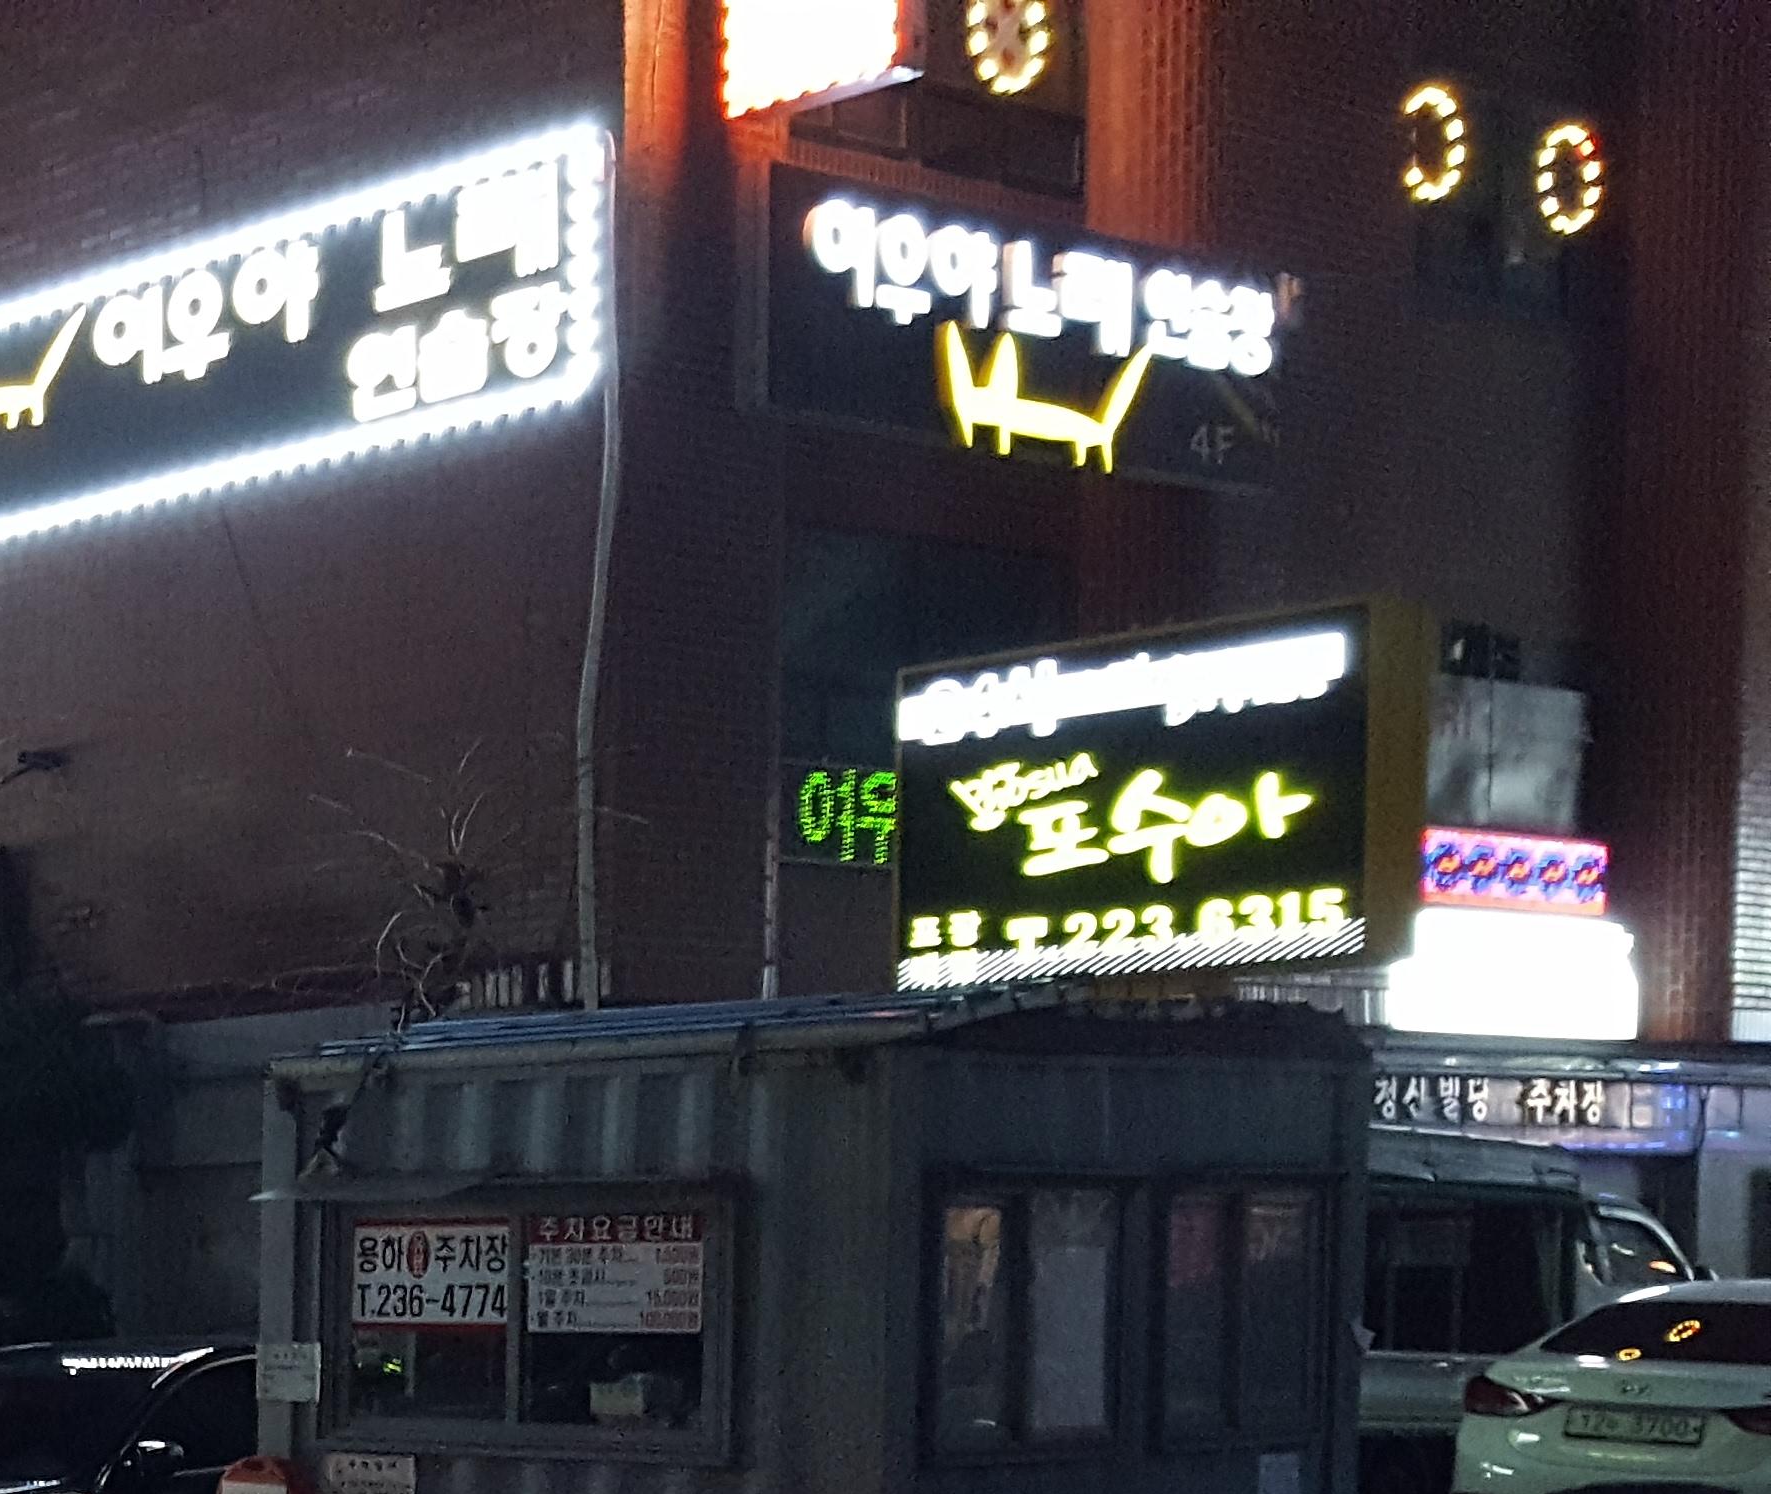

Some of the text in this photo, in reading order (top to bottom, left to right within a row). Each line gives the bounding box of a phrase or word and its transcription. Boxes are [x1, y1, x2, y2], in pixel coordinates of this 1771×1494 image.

[807, 200, 997, 328] 여우야
[93, 239, 319, 384] 여우야
[1018, 770, 1311, 883] 포수아
[1526, 1078, 1604, 1125] 주차장
[435, 1235, 506, 1272] 주차장
[358, 1284, 506, 1318] T.236-4774
